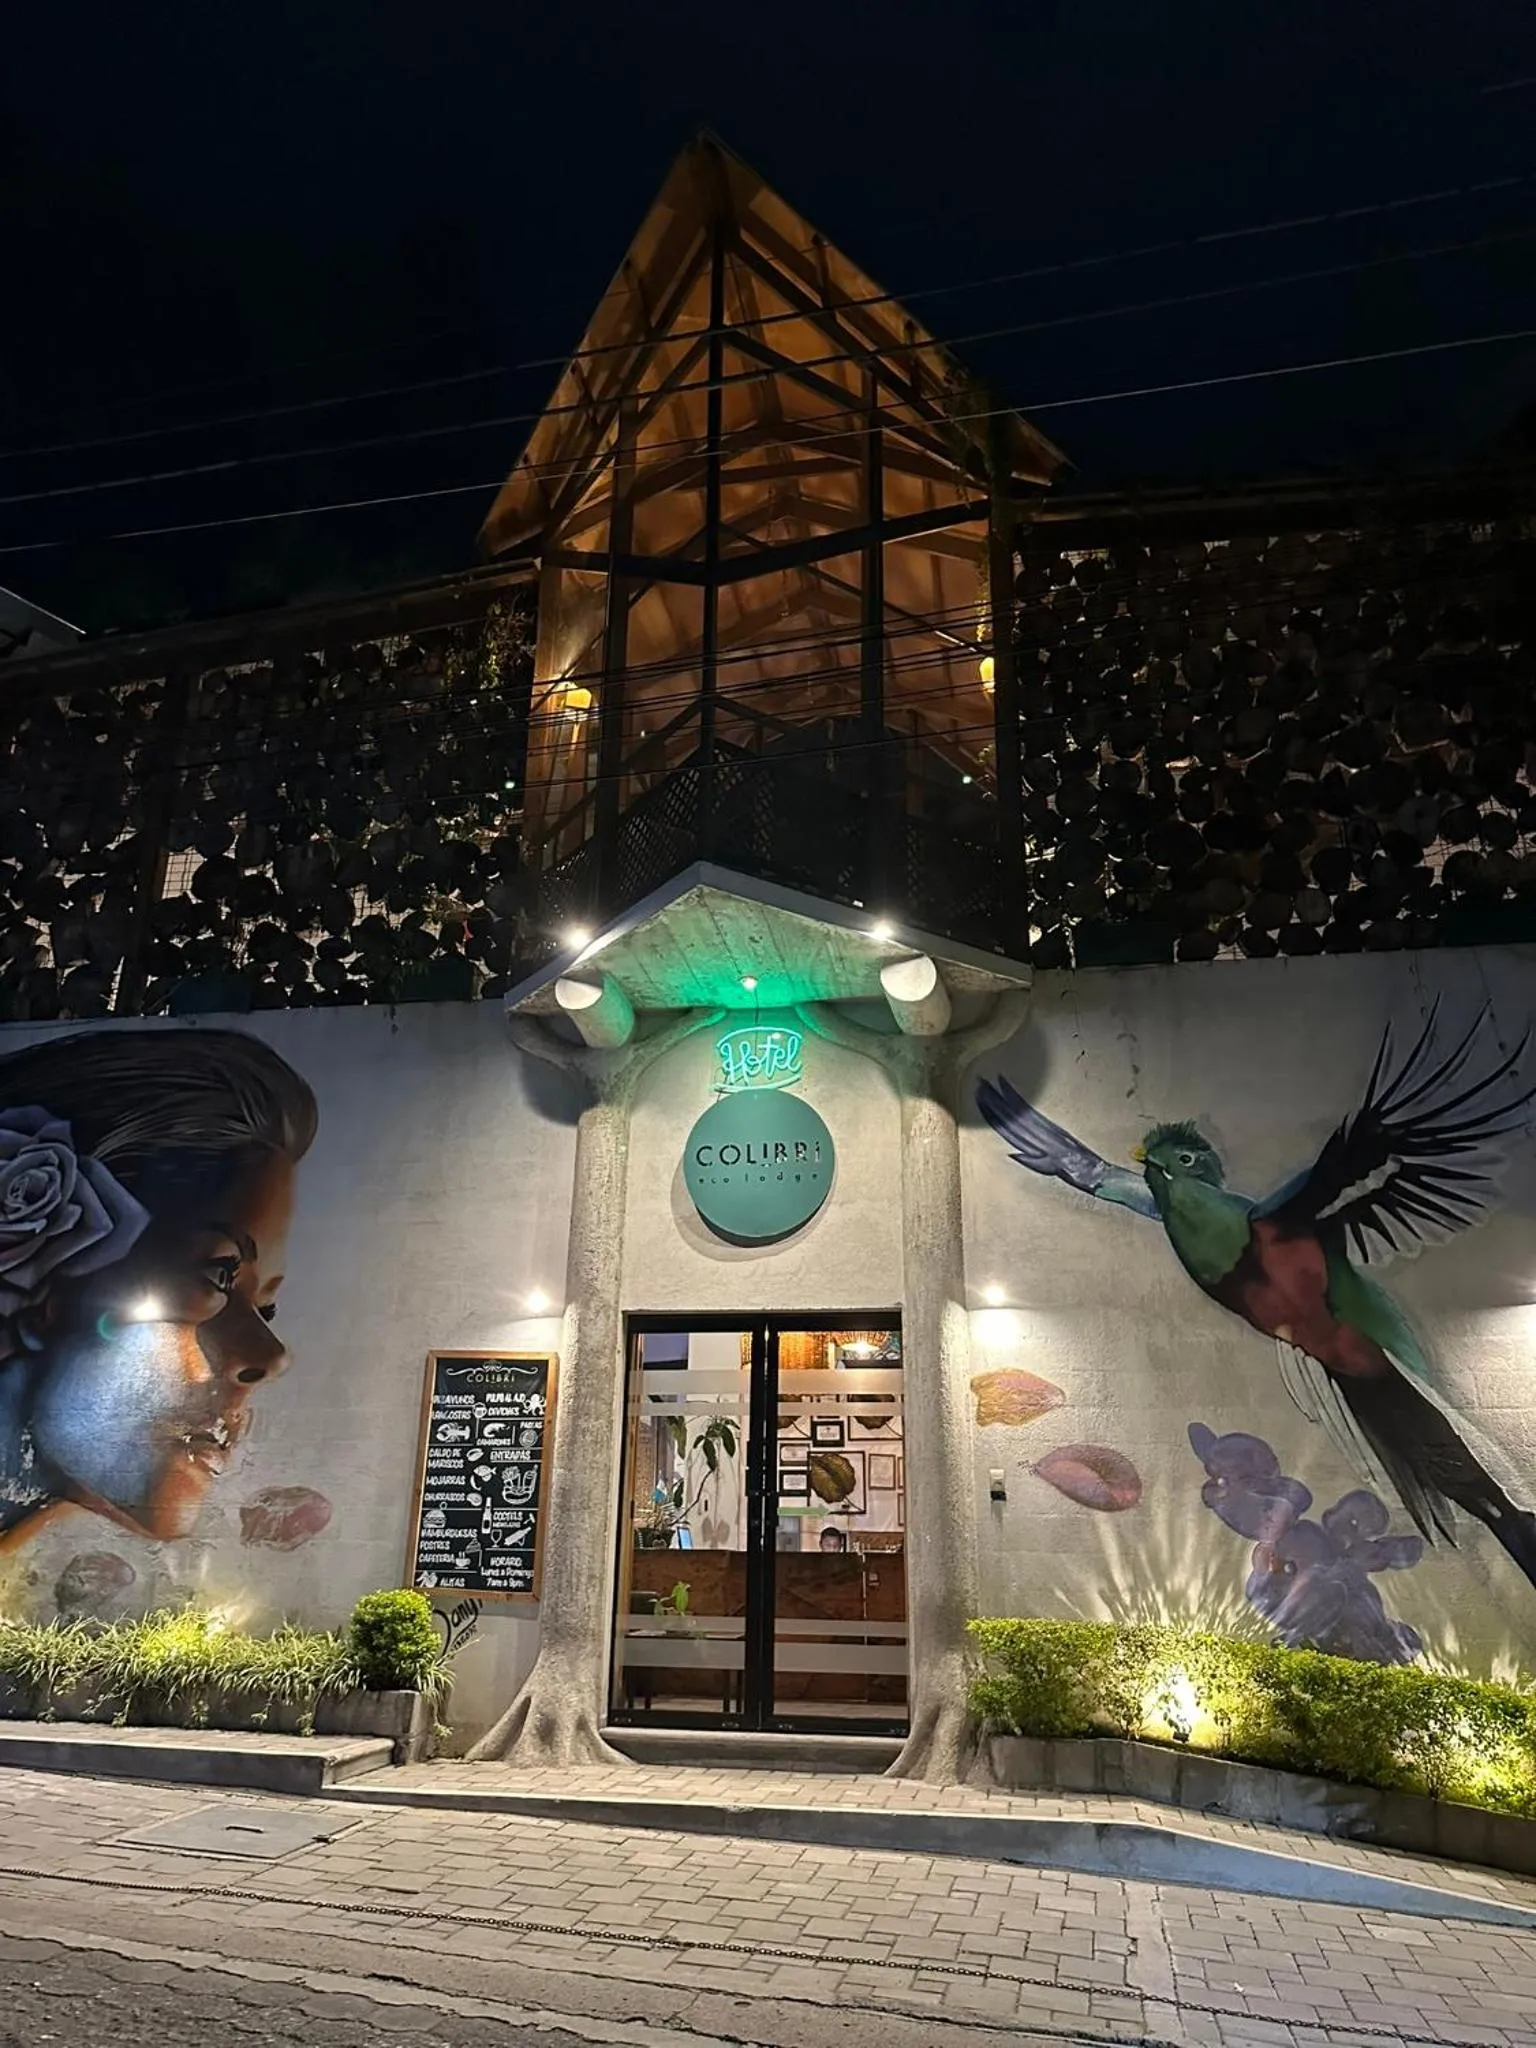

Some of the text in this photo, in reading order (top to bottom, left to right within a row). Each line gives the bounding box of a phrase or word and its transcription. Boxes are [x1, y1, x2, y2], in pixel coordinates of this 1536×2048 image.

[719, 1036, 802, 1086] Hotel
[466, 1373, 515, 1384] COLIBRI
[490, 1450, 531, 1460] ENTRADAS
[426, 1475, 466, 1485] MOJARRAS
[420, 1540, 451, 1550] POSTRES
[440, 1577, 465, 1588] ALITAS
